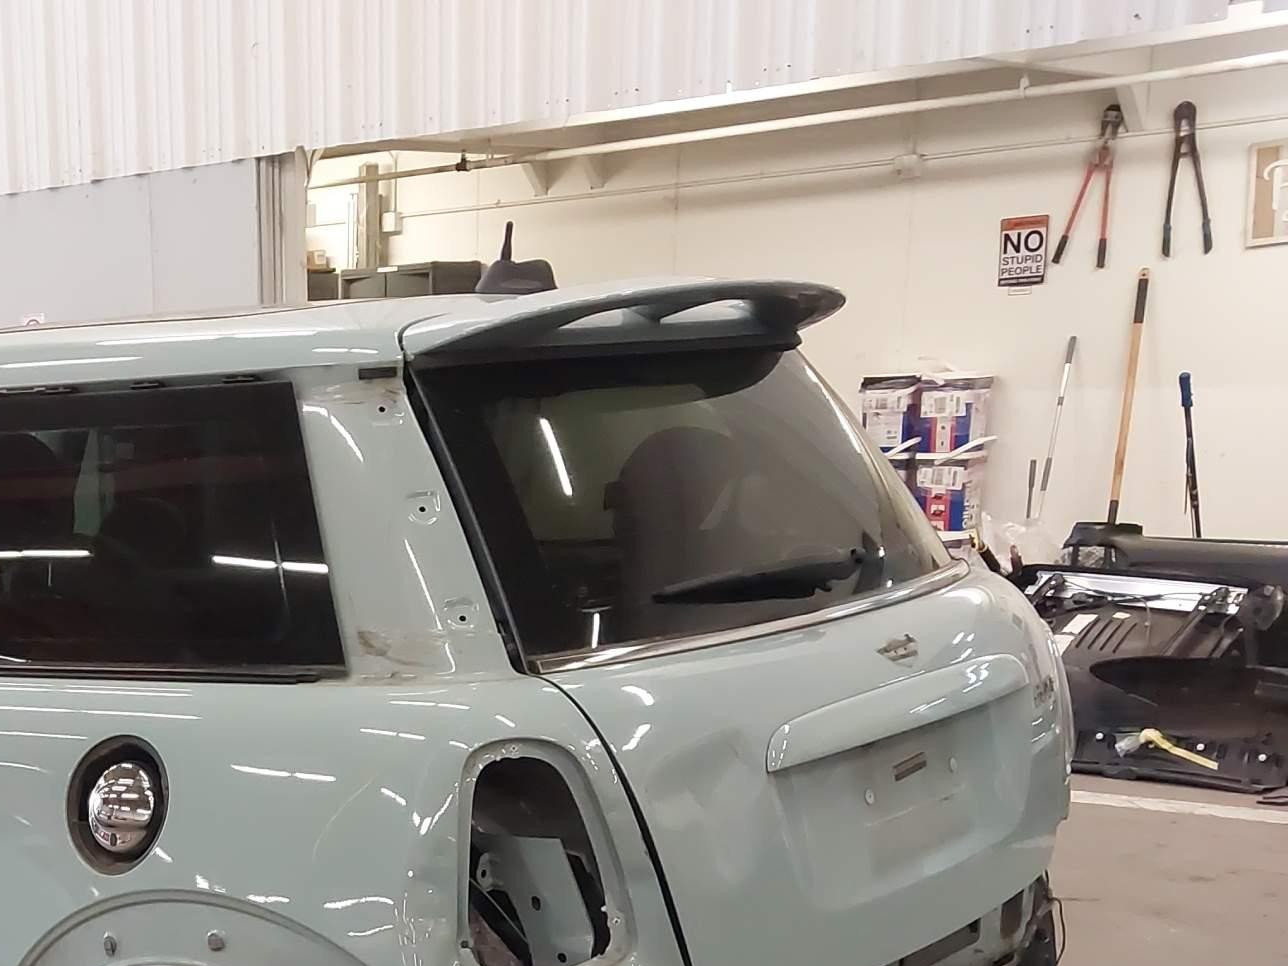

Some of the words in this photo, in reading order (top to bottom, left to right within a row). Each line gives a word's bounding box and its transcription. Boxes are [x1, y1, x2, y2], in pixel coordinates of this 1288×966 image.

[1003, 229, 1044, 255] NO
[1002, 254, 1043, 266] STUPID
[1001, 264, 1043, 277] PEOPLE
